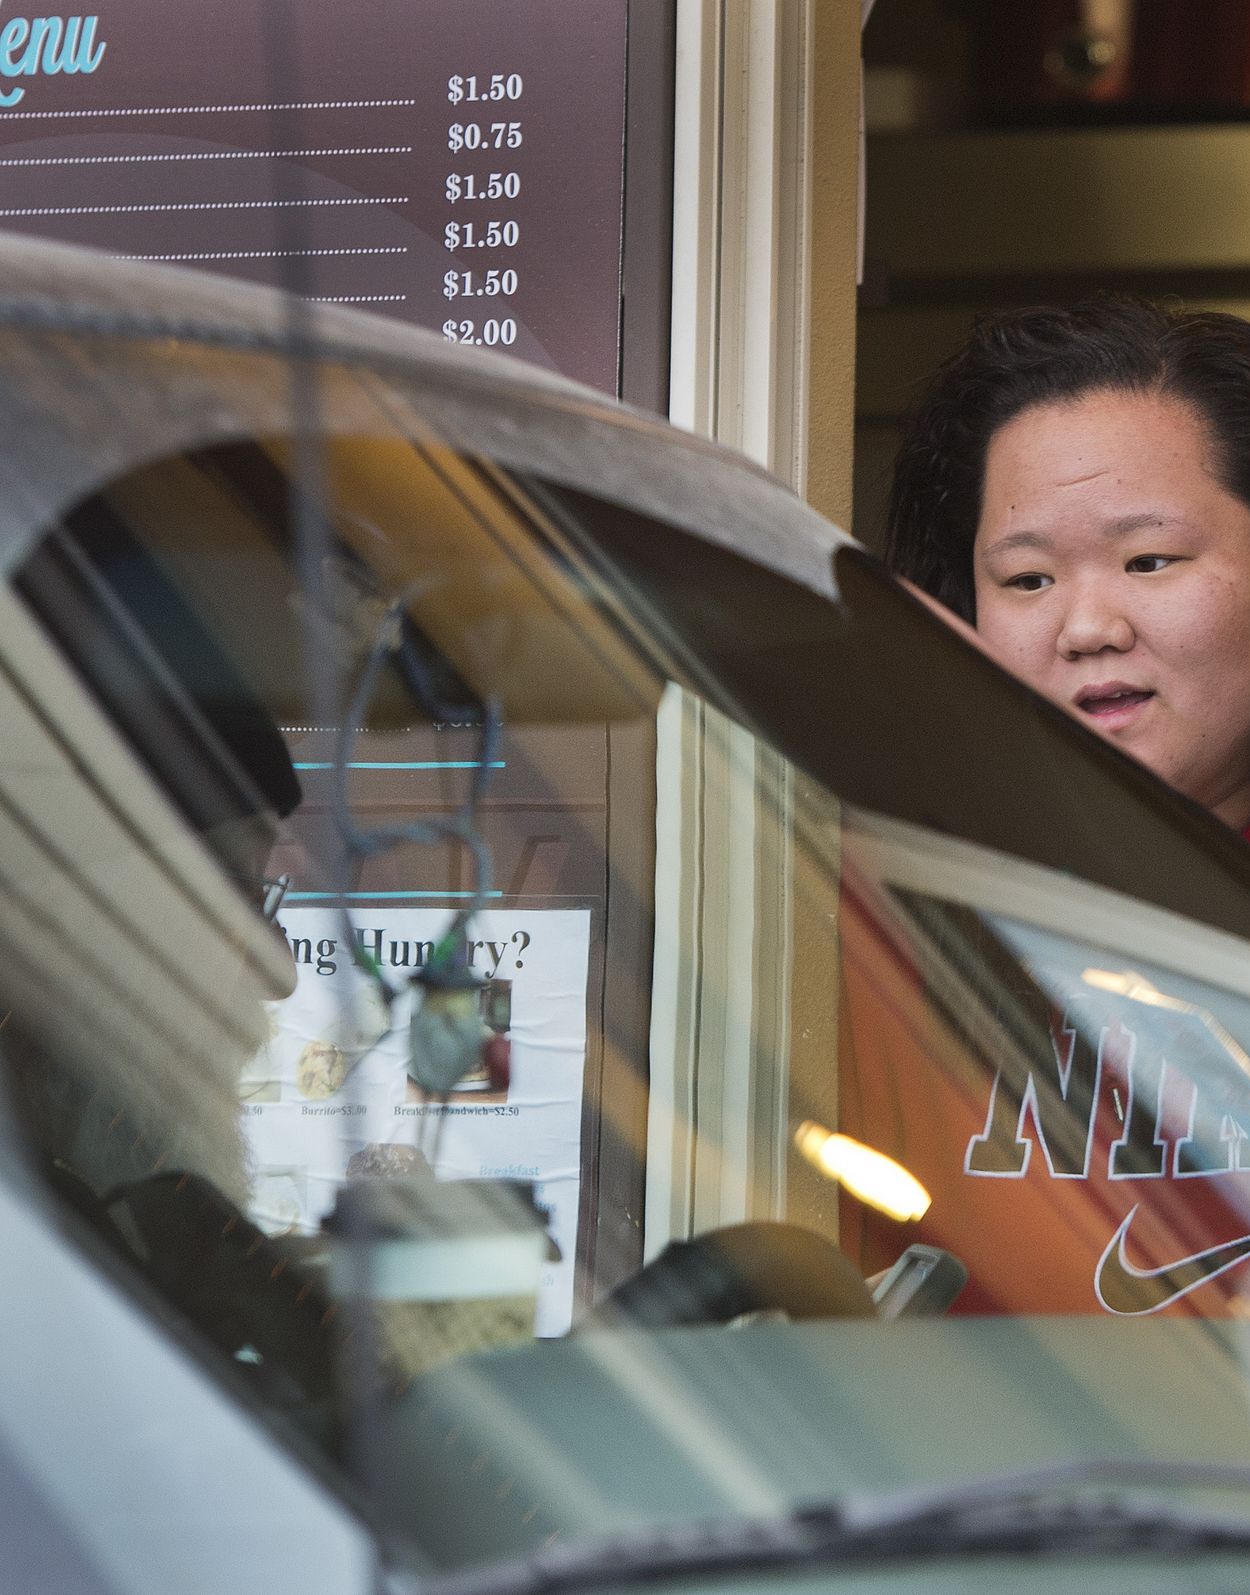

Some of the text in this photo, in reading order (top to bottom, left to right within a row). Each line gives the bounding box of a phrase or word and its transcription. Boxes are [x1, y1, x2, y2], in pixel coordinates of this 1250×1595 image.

[447, 73, 523, 106] $1.50
[447, 121, 523, 154] $0.75
[445, 172, 521, 204] $1.50
[444, 220, 519, 252] $1.50
[443, 269, 518, 301] $1.50
[442, 318, 517, 346] $2.00
[351, 927, 531, 979] Hunry?
